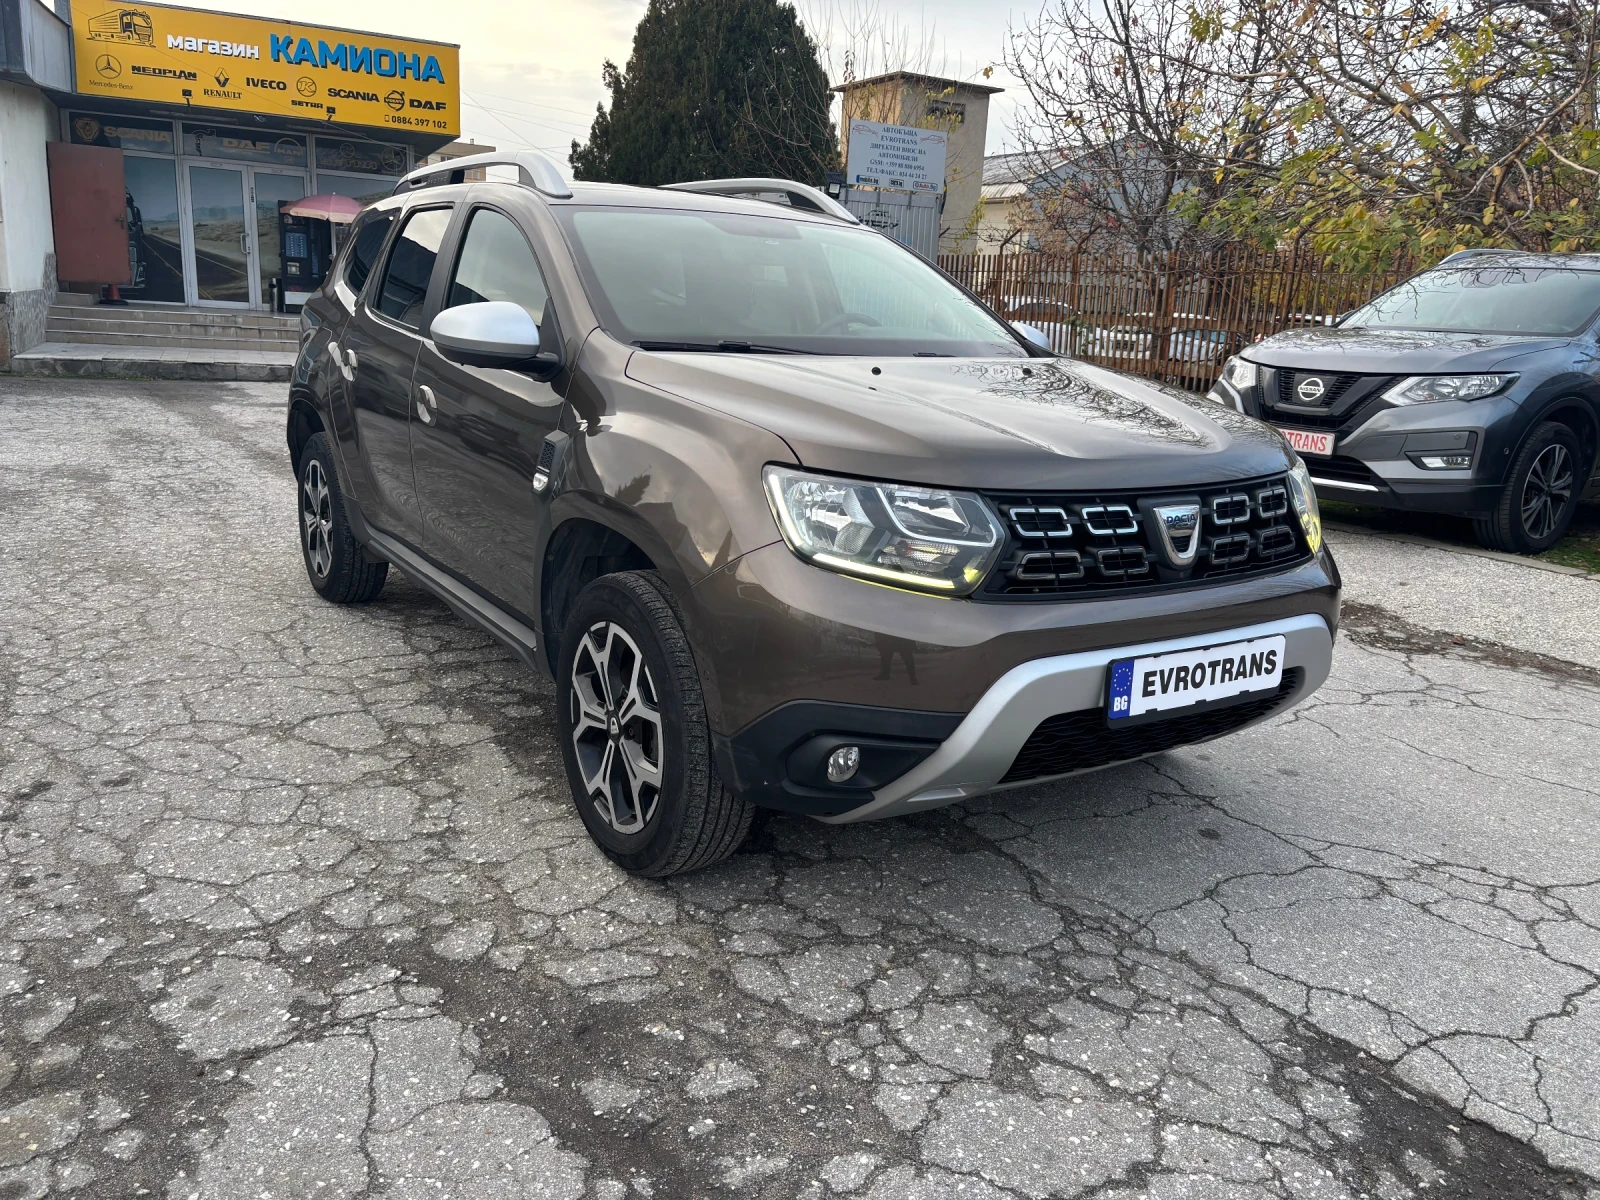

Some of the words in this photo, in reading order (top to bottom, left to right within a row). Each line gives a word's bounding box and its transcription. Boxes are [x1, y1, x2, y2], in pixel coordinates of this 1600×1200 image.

[167, 34, 260, 59] магазин
[270, 34, 445, 84] КАМИОНА
[131, 65, 197, 81] NEOPLAN
[89, 80, 133, 90] Mercedes-Benz
[246, 77, 287, 91] IVECO
[203, 88, 242, 99] RENAULT
[327, 88, 380, 102] SCANIA
[409, 99, 446, 111] DAF
[391, 115, 412, 125] 0884
[414, 118, 430, 127] 397
[432, 120, 447, 129] 102
[104, 126, 171, 143] SCANIA
[881, 135, 918, 145] EVROTRANS
[222, 138, 270, 151] DAF
[1166, 513, 1197, 525] DACIA
[1142, 649, 1278, 698] EVROTRANS
[1113, 696, 1128, 712] BG
